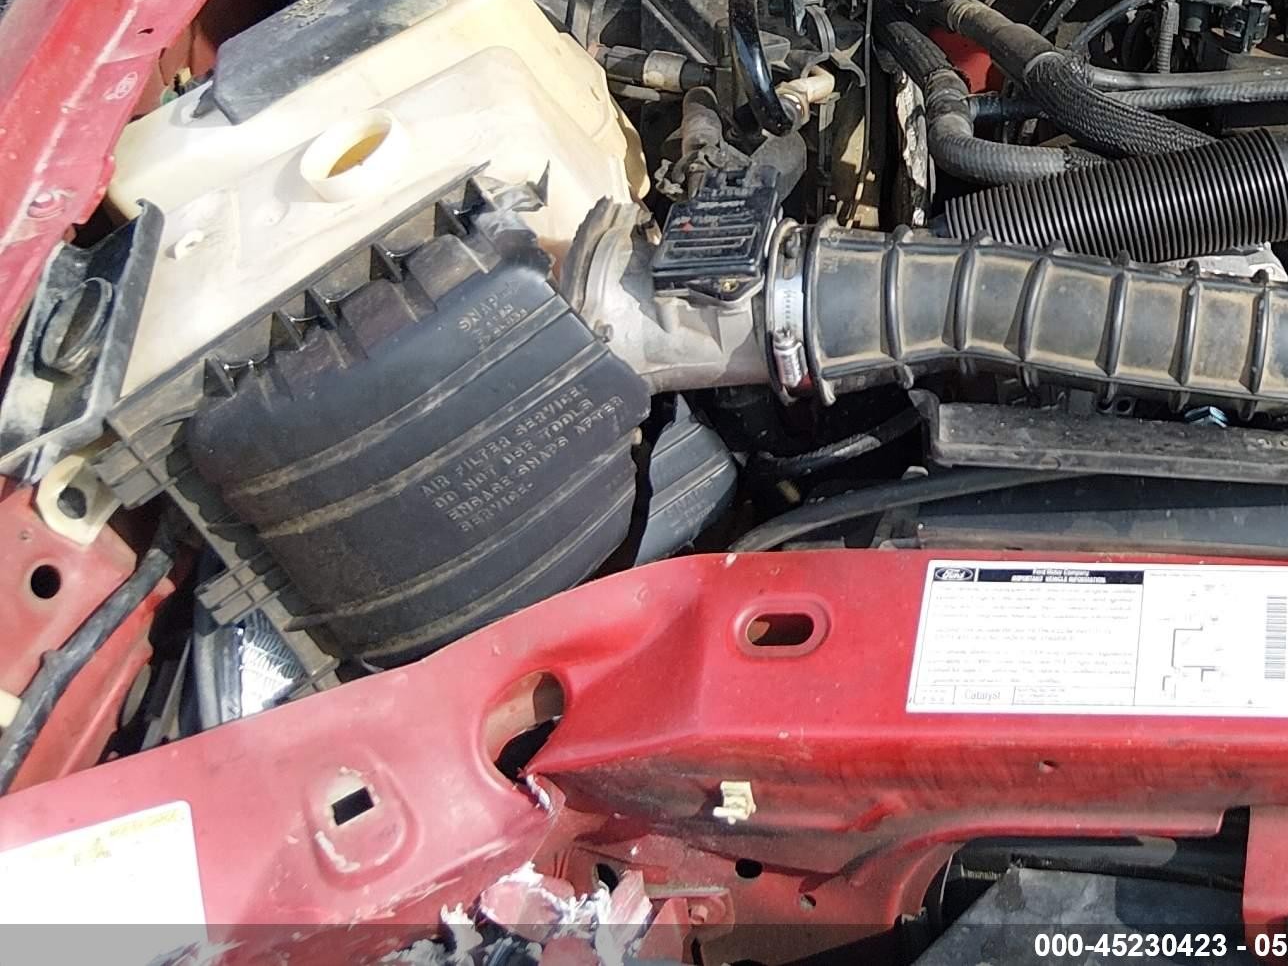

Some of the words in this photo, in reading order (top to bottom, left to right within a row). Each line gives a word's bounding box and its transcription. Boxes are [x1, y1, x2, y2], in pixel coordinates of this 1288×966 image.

[431, 489, 459, 511] DO
[464, 464, 499, 495] NOT
[502, 442, 535, 467] USE
[538, 398, 595, 447] TOOLS
[515, 437, 568, 479] SNAPS
[419, 475, 450, 498] AIR
[964, 689, 1001, 702] Catalyst
